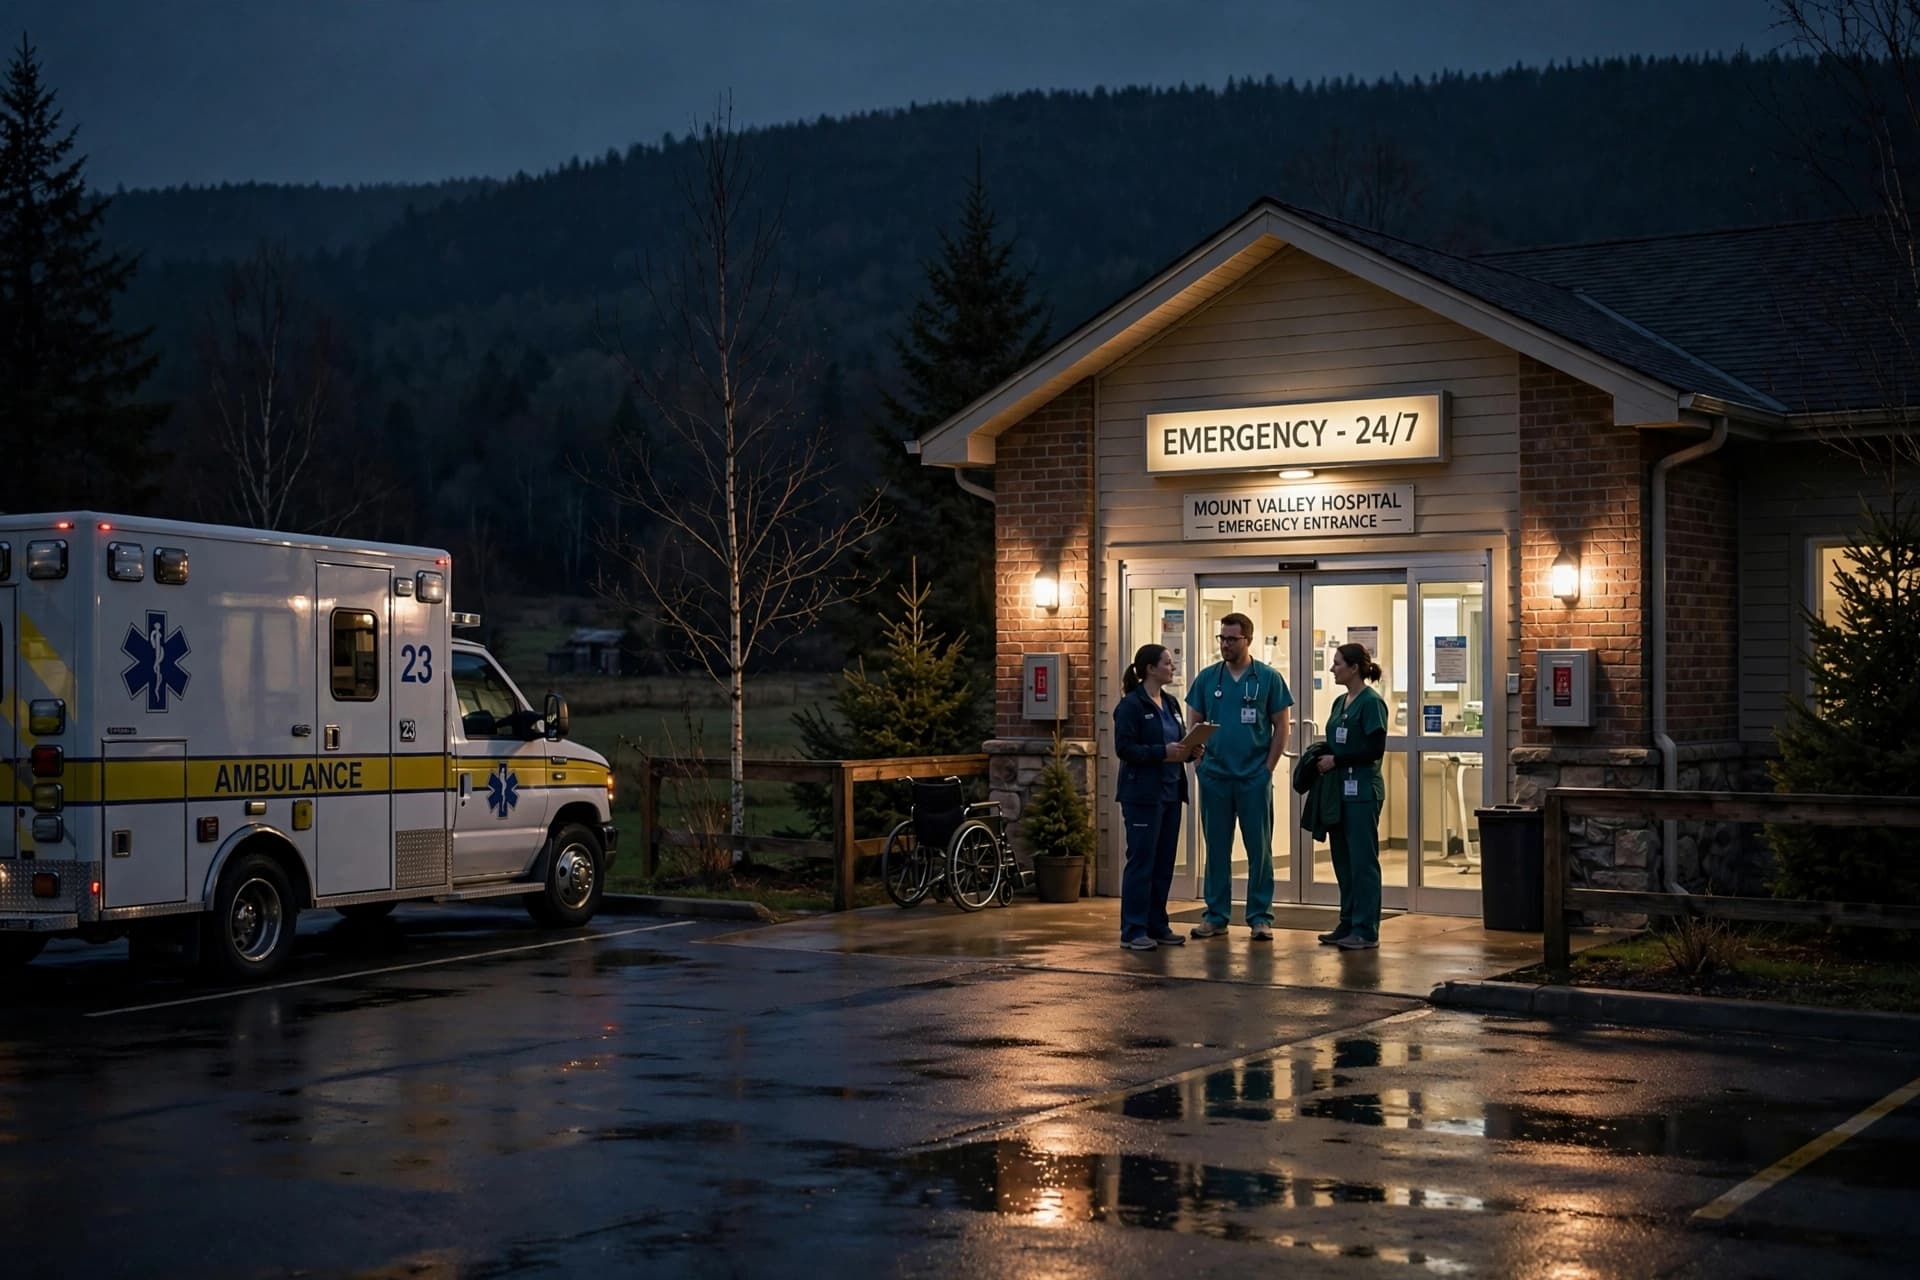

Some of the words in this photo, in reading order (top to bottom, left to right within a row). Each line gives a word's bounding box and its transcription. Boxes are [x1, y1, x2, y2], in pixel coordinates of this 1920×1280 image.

[1163, 418, 1328, 456] EMERGENCY
[1355, 412, 1419, 446] 24/7
[1194, 499, 1252, 517] MOUNT
[1256, 496, 1316, 514] VALLEY
[1321, 493, 1402, 512] HOSPITAL
[1218, 517, 1300, 534] EMERGENCY
[1303, 514, 1377, 531] ENTRANCE
[401, 644, 433, 684] 23
[402, 721, 416, 739] 23
[214, 761, 363, 793] AMBULANCE
